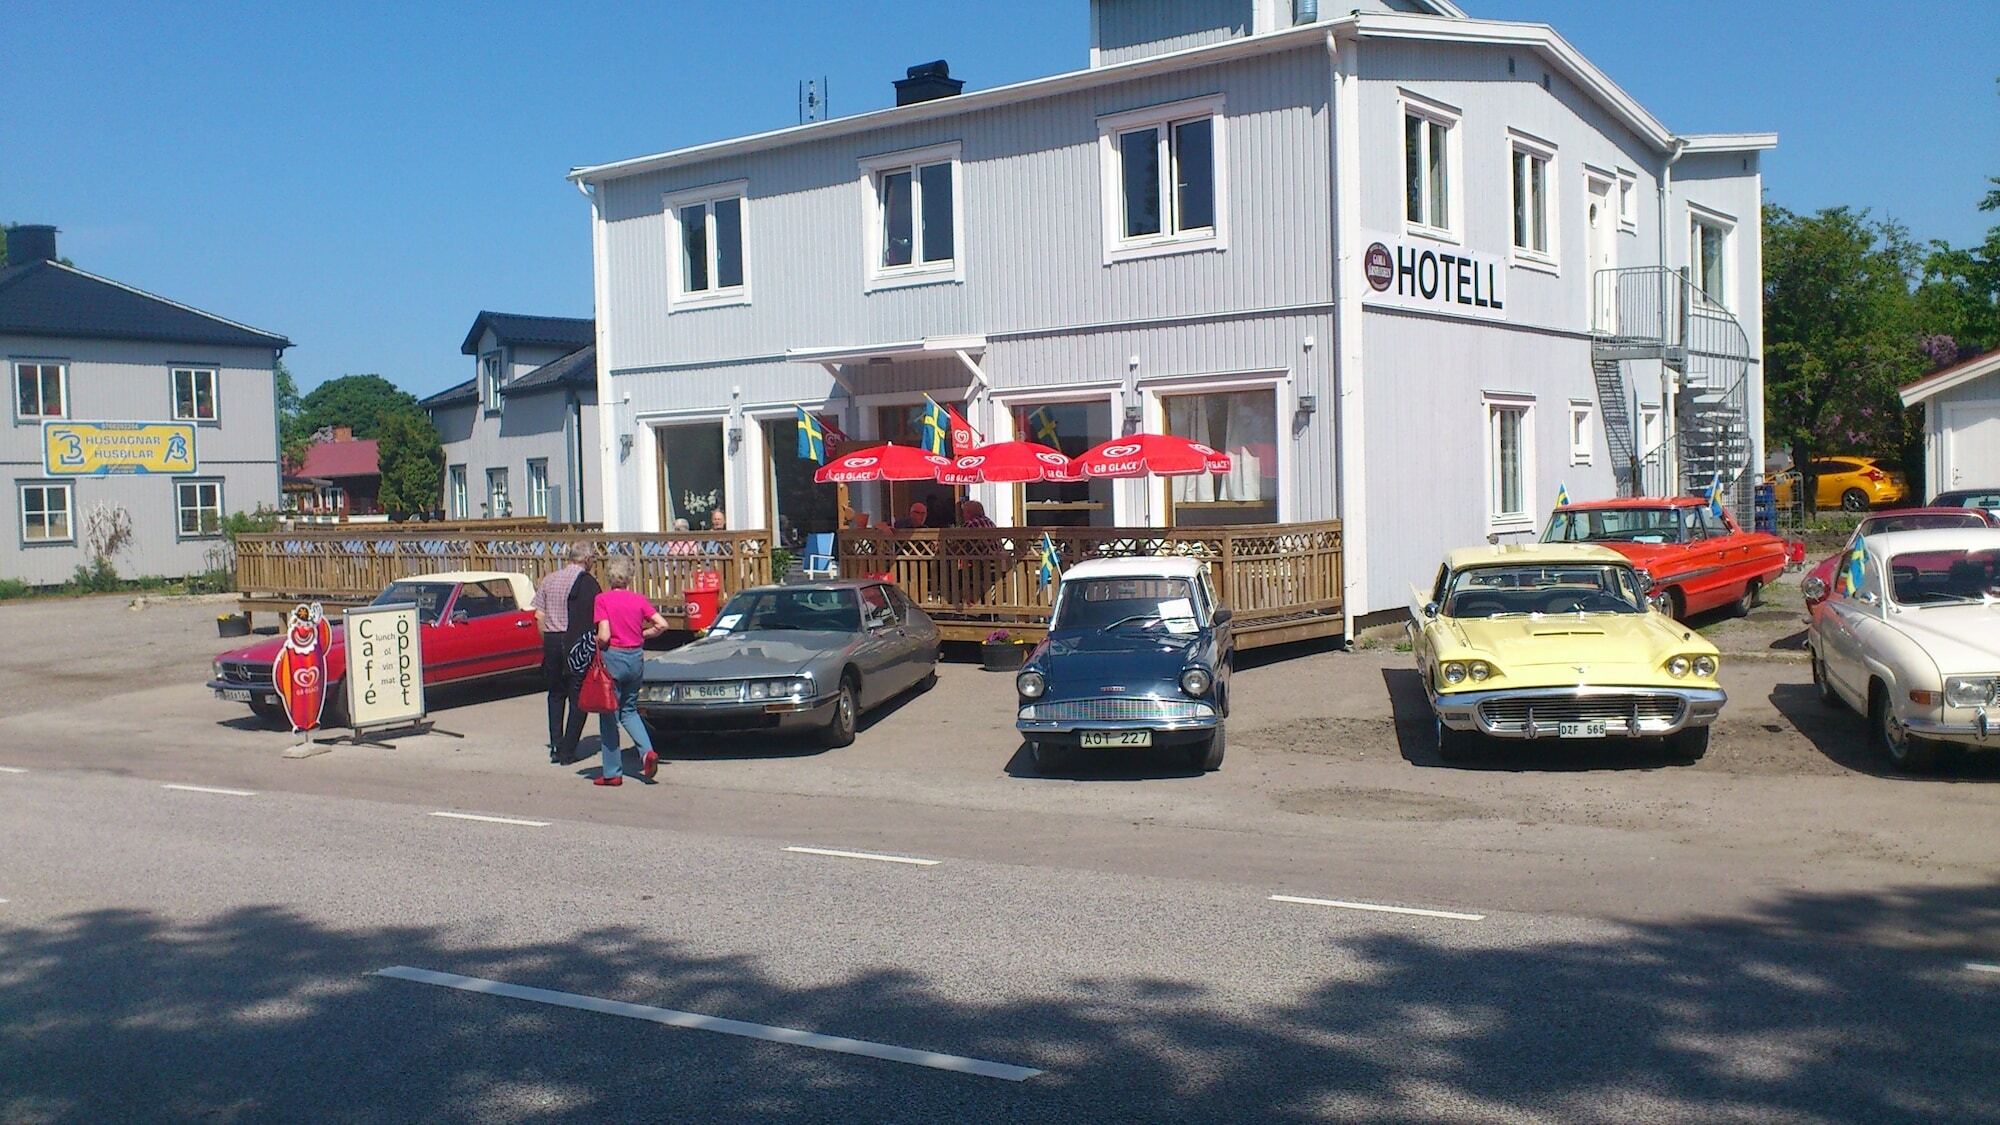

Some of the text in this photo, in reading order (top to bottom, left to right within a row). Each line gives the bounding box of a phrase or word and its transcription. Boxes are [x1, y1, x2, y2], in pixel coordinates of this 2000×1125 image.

[1397, 245, 1503, 310] HOTELL
[85, 435, 161, 445] HUSVAGNAR
[94, 449, 154, 459] HUSBILAR
[1093, 461, 1137, 473] GB GLACE
[846, 471, 872, 480] GLACE
[944, 474, 955, 482] GB
[375, 633, 396, 641] lunch
[382, 663, 394, 671] vin
[381, 677, 396, 685] mat
[1561, 725, 1605, 735] DZF 565
[1084, 732, 1148, 745] AOT 227
